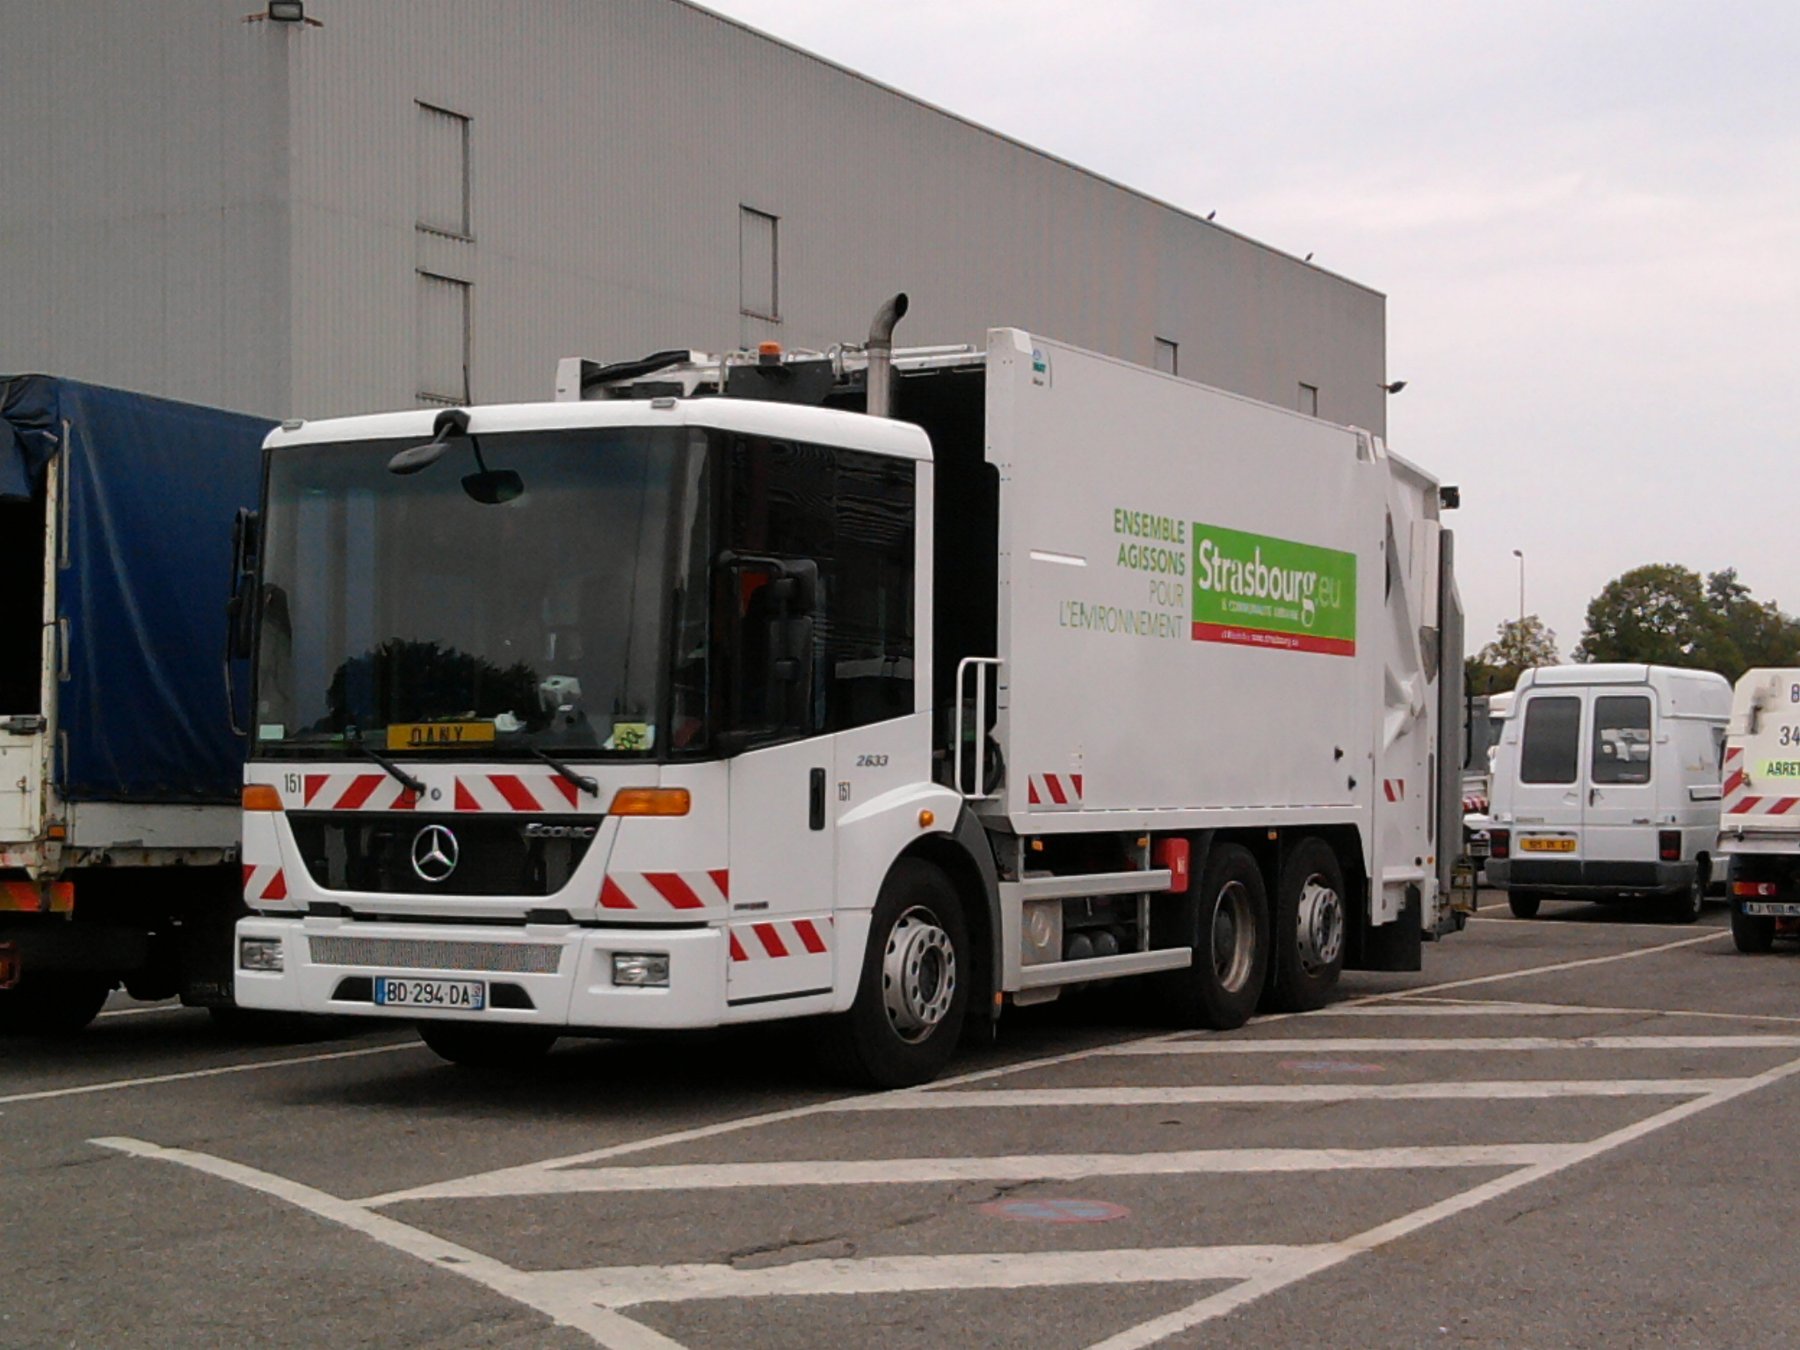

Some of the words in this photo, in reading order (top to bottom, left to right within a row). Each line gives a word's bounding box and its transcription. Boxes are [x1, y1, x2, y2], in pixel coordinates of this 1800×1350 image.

[1114, 508, 1186, 544] ENSEMBLE
[1117, 542, 1186, 577] AGISSONS
[1149, 579, 1184, 608] POUR
[1060, 600, 1184, 639] L'ENVIRONNEMENT
[856, 754, 889, 767] 2633
[284, 773, 302, 794] 151
[838, 781, 850, 802] 151
